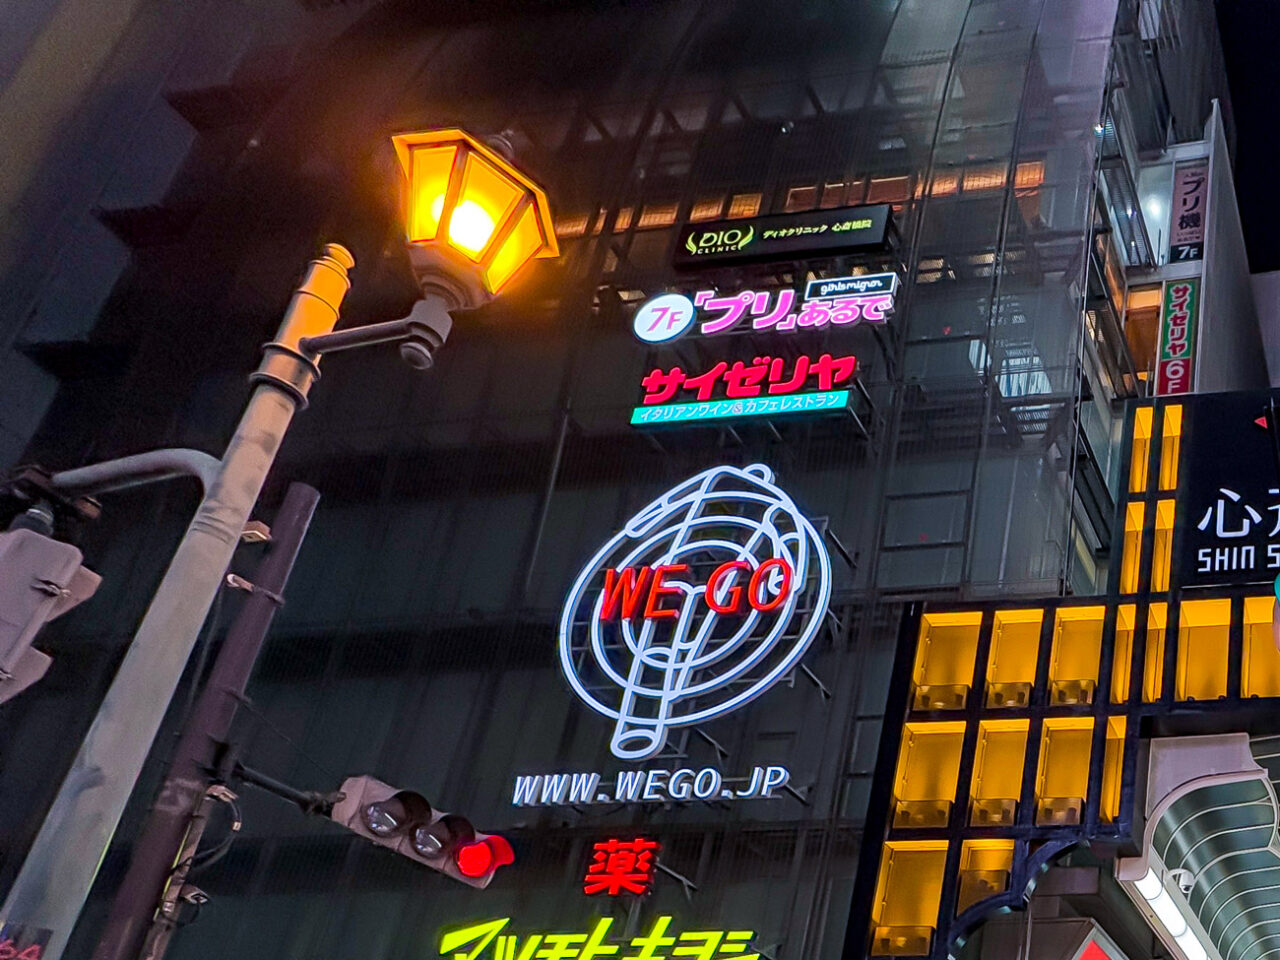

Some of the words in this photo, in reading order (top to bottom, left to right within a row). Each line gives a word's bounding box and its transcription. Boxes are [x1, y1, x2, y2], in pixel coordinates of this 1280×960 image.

[698, 245, 738, 255] CLINIC
[700, 229, 742, 247] DIO
[1178, 246, 1199, 259] 7F
[646, 307, 683, 333] 7F
[694, 289, 895, 334] 「プリ」あるで
[1168, 285, 1191, 357] サイゼリヤ
[642, 354, 856, 404] サイゼリヤ
[512, 766, 790, 805] WWW.WEGO.JP
[584, 838, 659, 896] 薬
